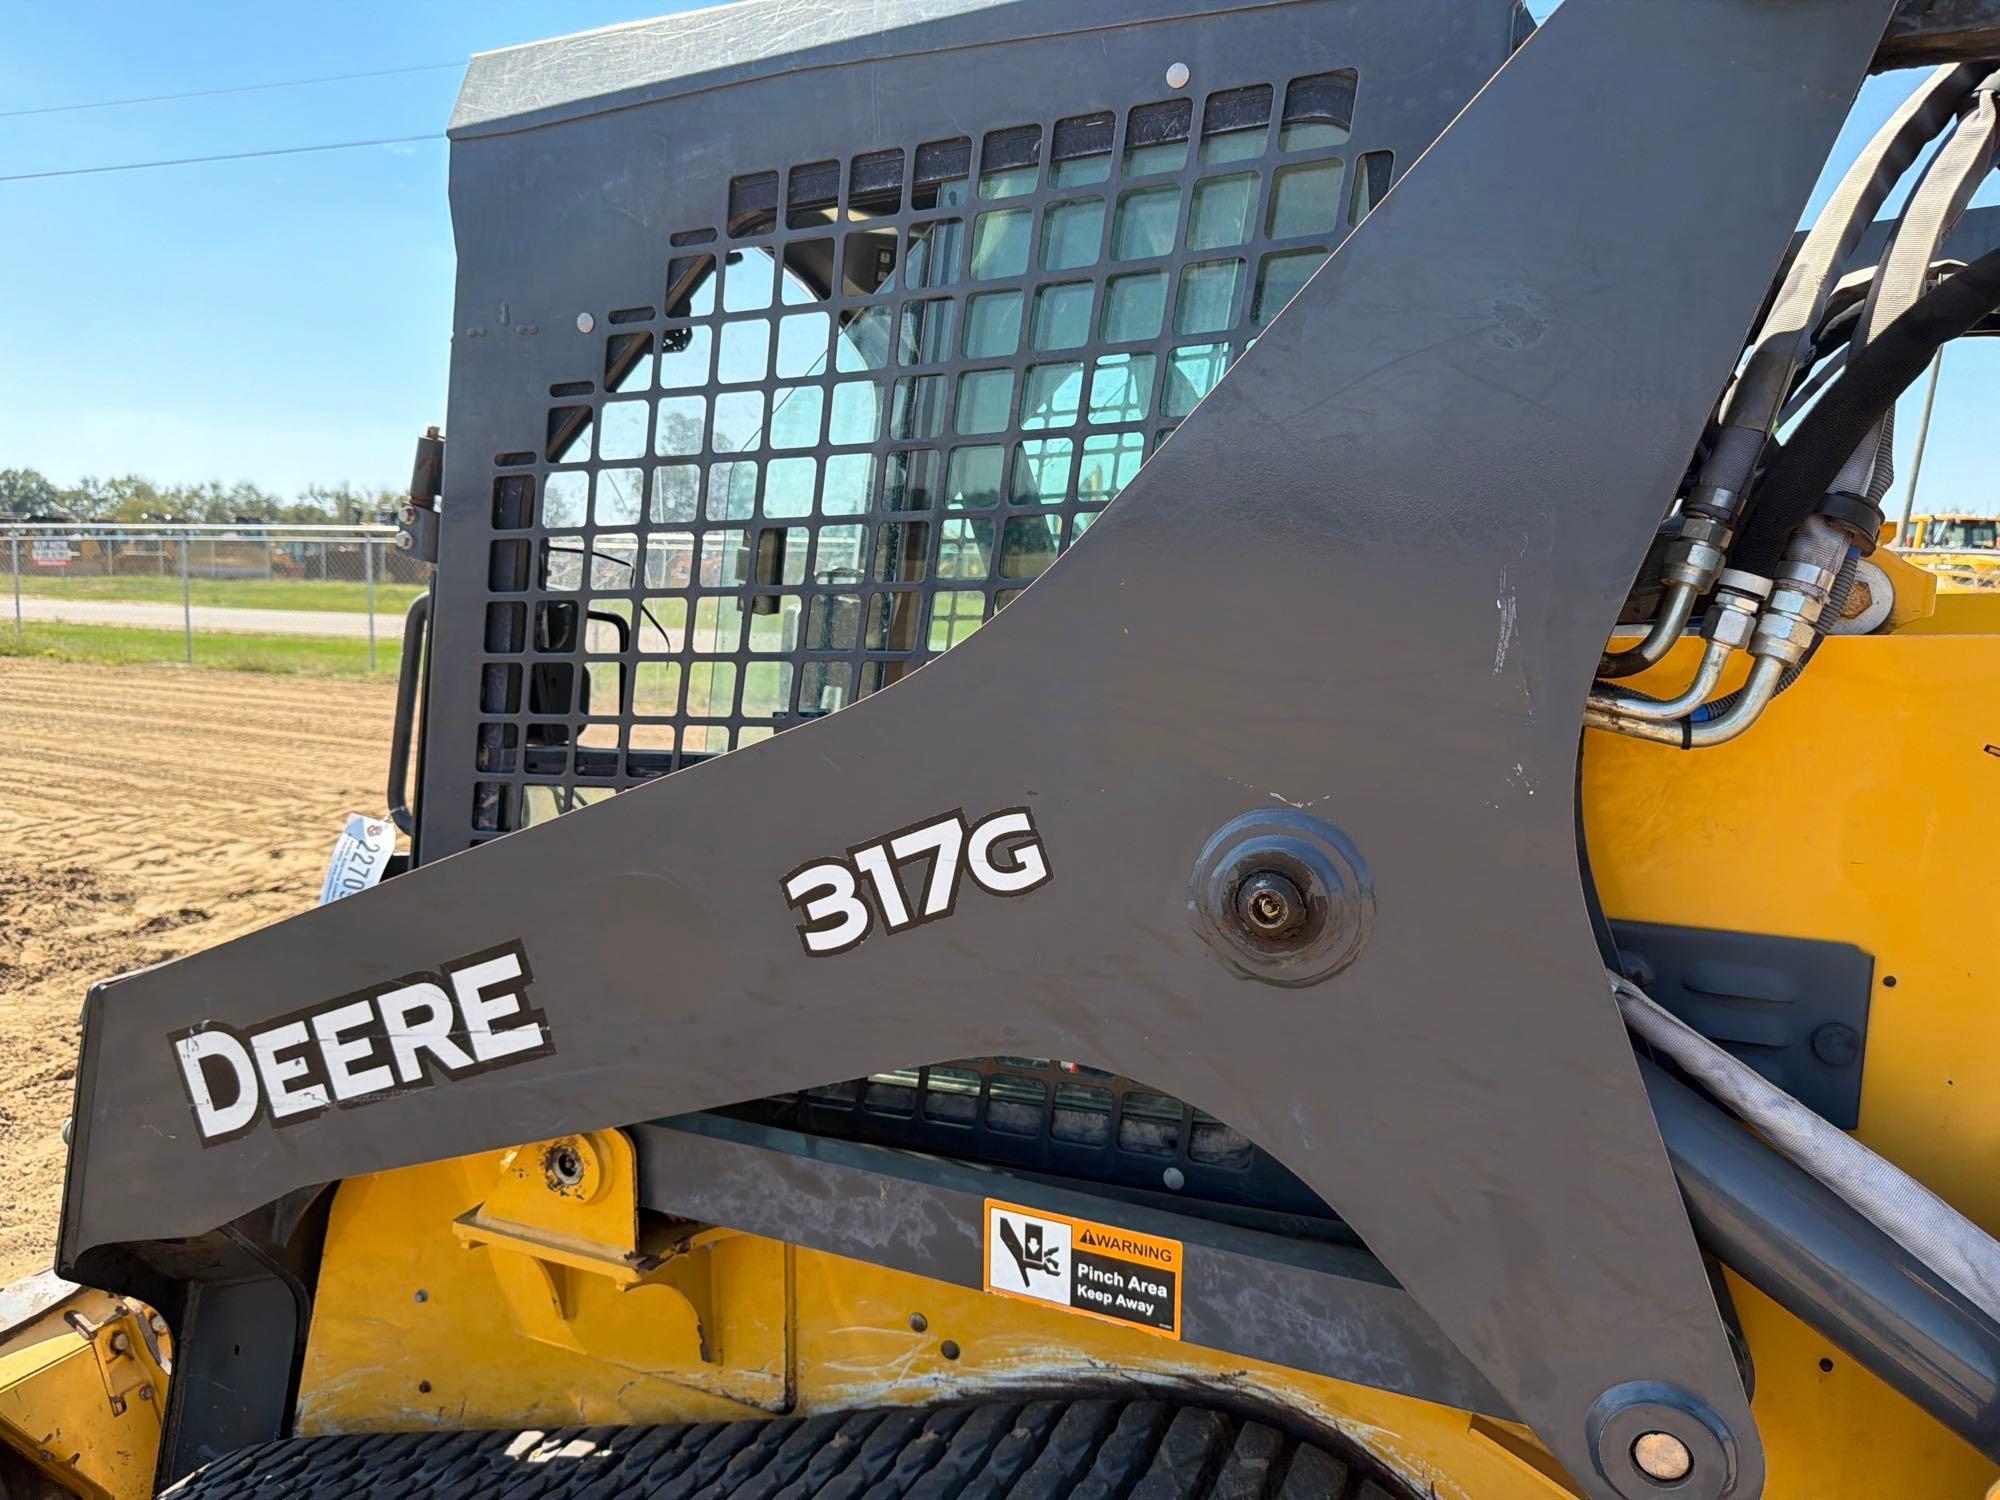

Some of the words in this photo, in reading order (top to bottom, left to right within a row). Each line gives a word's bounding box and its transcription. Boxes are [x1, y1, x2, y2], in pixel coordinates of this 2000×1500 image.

[786, 812, 1047, 951] 317G
[175, 952, 544, 1138] DEERE
[1096, 1233, 1172, 1262] WARNING
[1077, 1262, 1124, 1288] Pinch
[1128, 1275, 1168, 1299] Area
[1077, 1283, 1113, 1306] Keep
[1115, 1293, 1155, 1316] Away
